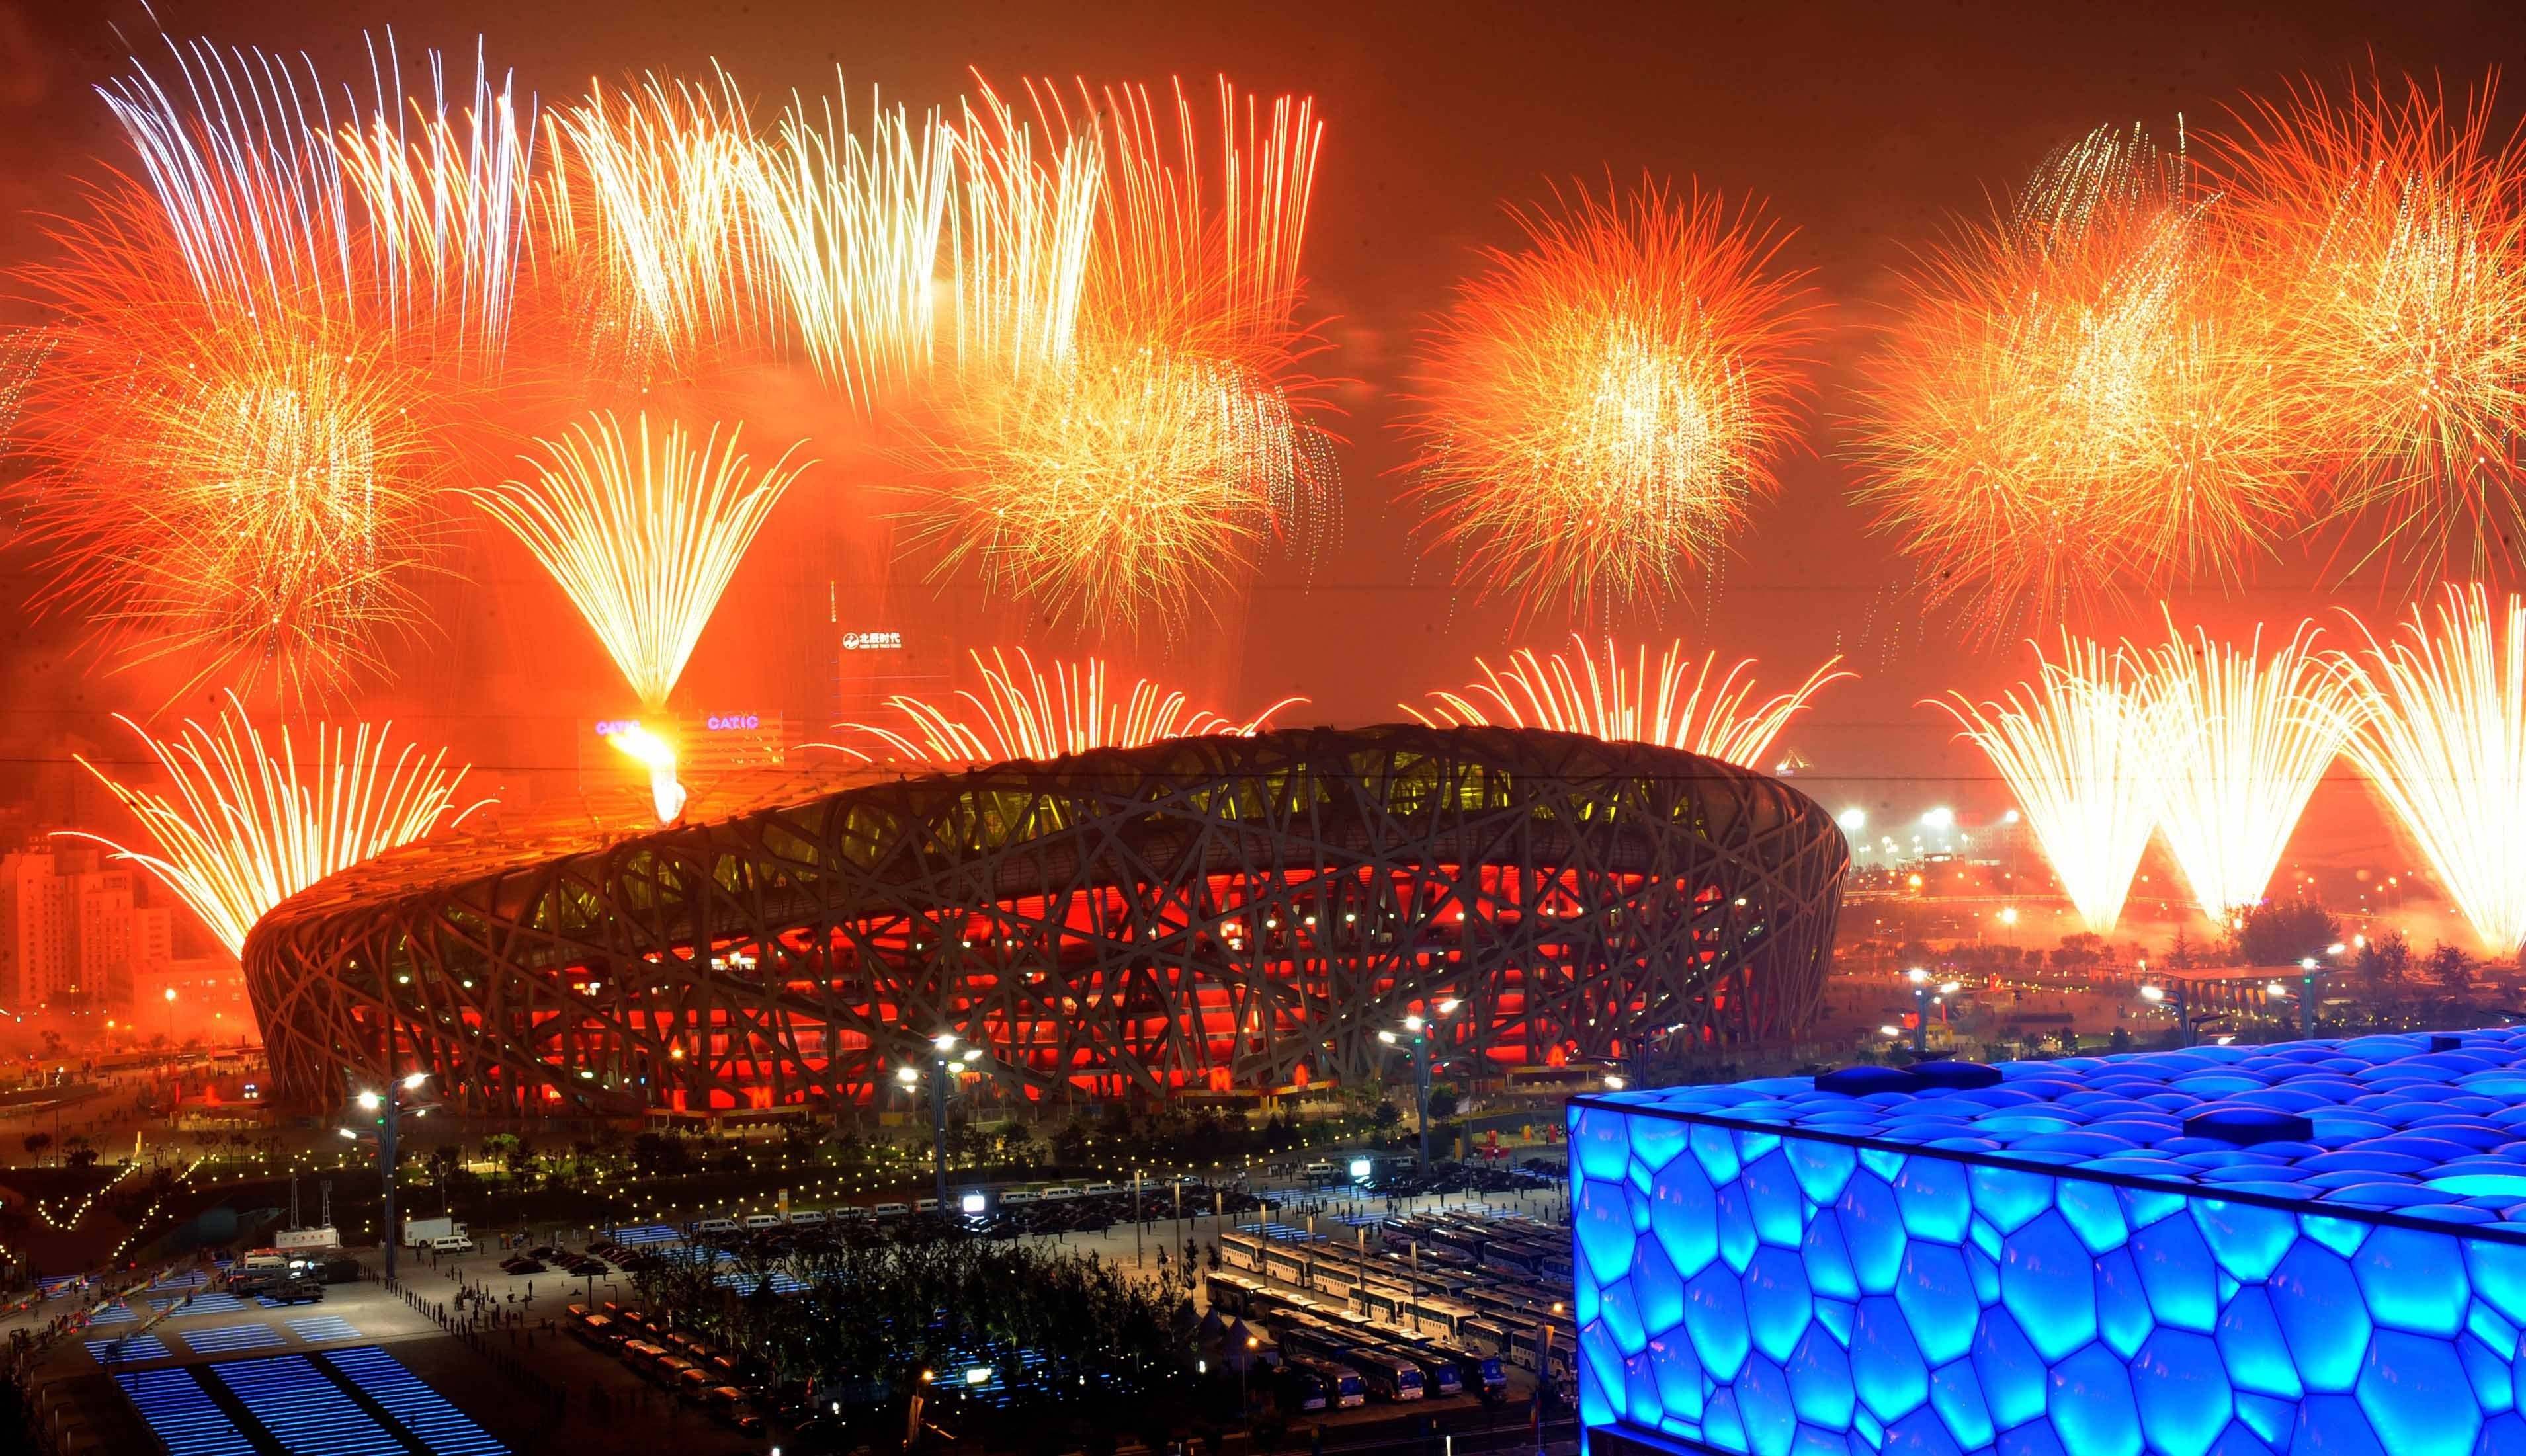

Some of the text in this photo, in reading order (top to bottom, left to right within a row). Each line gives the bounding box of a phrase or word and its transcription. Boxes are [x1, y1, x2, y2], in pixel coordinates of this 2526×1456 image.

[859, 632, 900, 643] 北辰时代
[708, 716, 758, 730] CATIC
[1210, 1067, 1232, 1092] M
[1294, 1063, 1308, 1086] A
[751, 1087, 772, 1110] M
